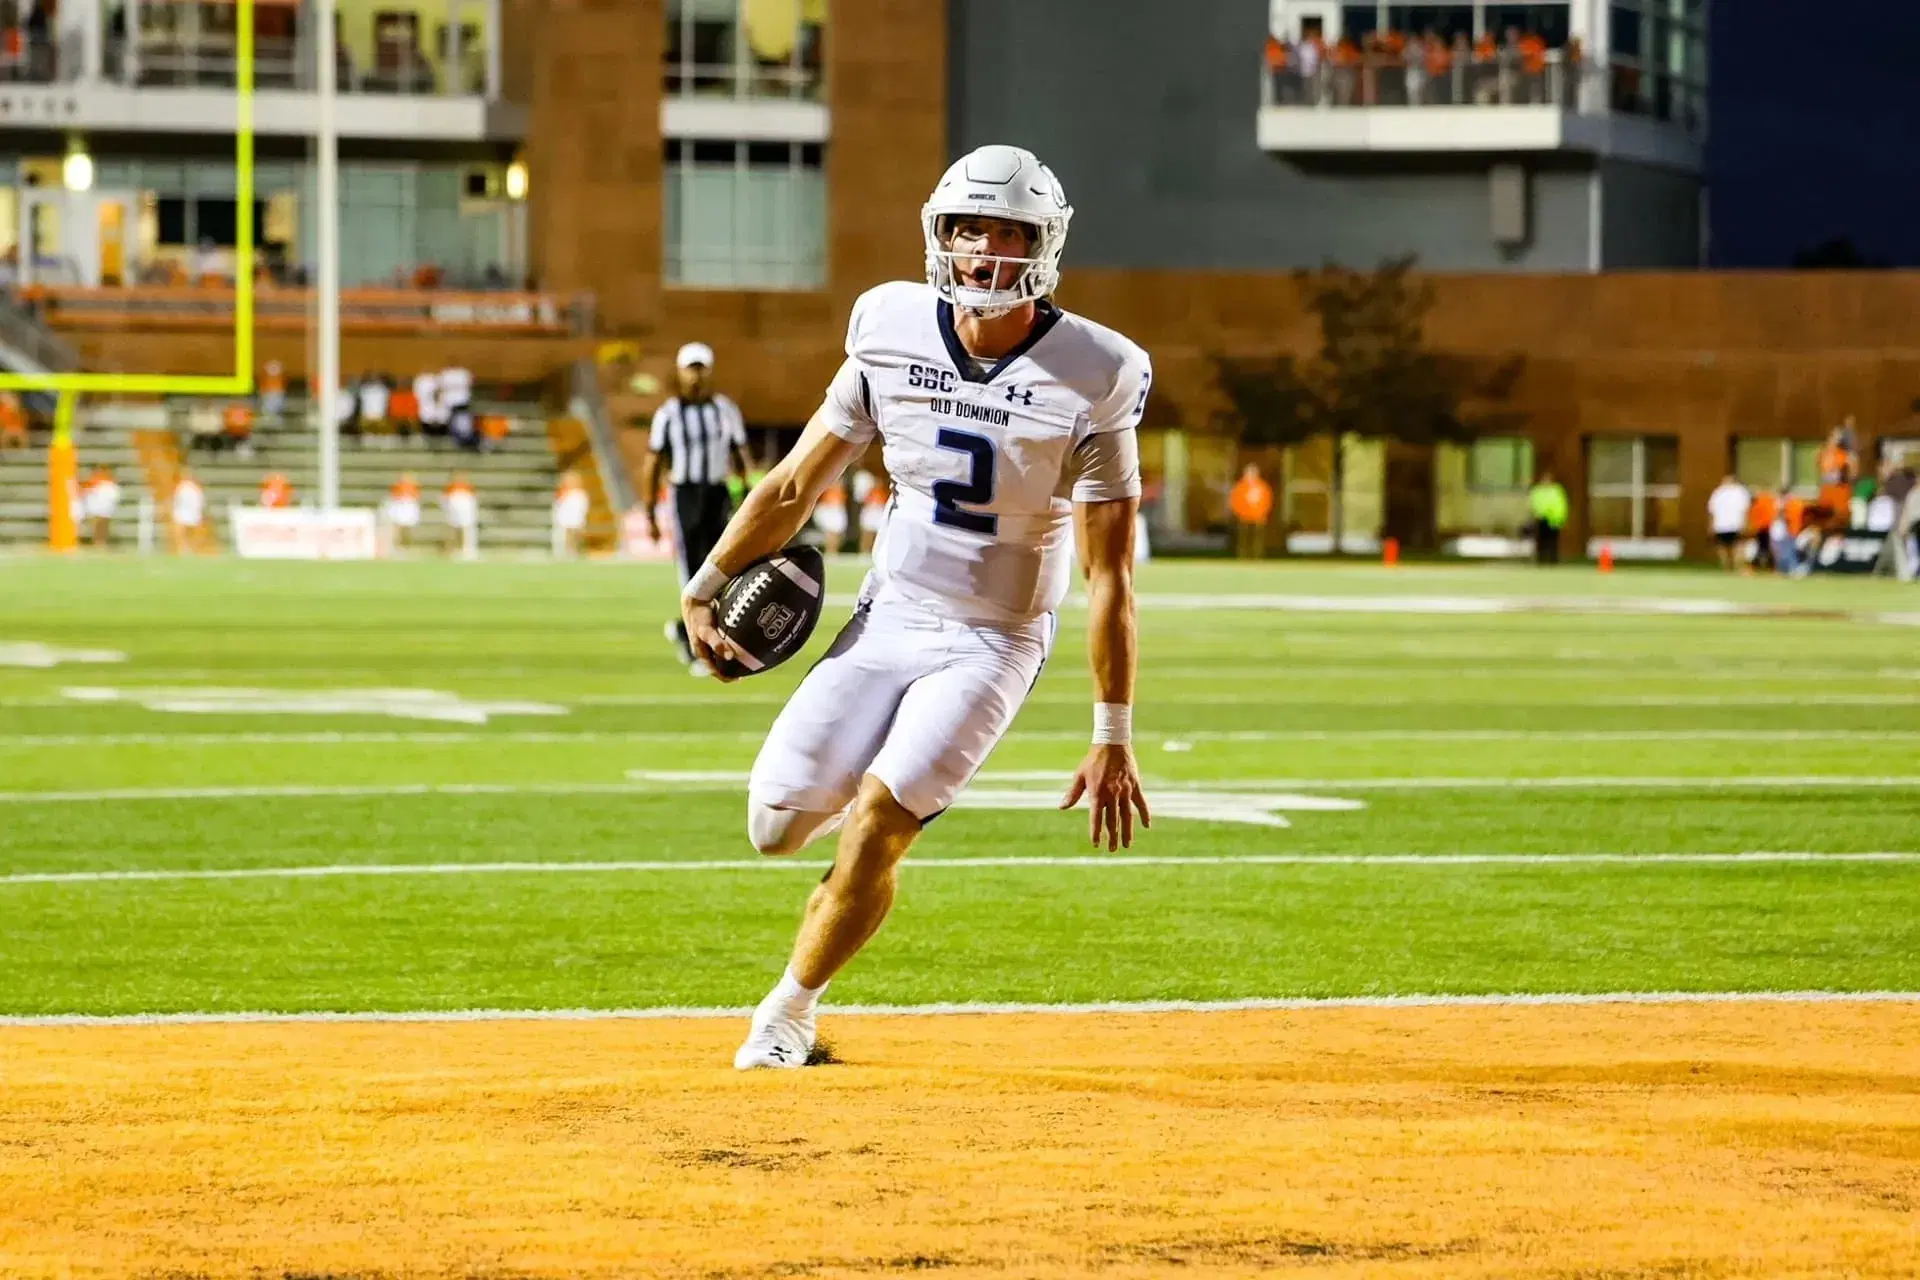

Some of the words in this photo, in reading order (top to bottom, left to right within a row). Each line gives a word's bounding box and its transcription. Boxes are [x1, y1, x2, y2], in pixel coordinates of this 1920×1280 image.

[909, 364, 954, 392] SBC
[930, 398, 952, 414] OLD
[956, 401, 1009, 427] DOMINION
[933, 426, 998, 536] 2
[766, 608, 792, 637] ODU
